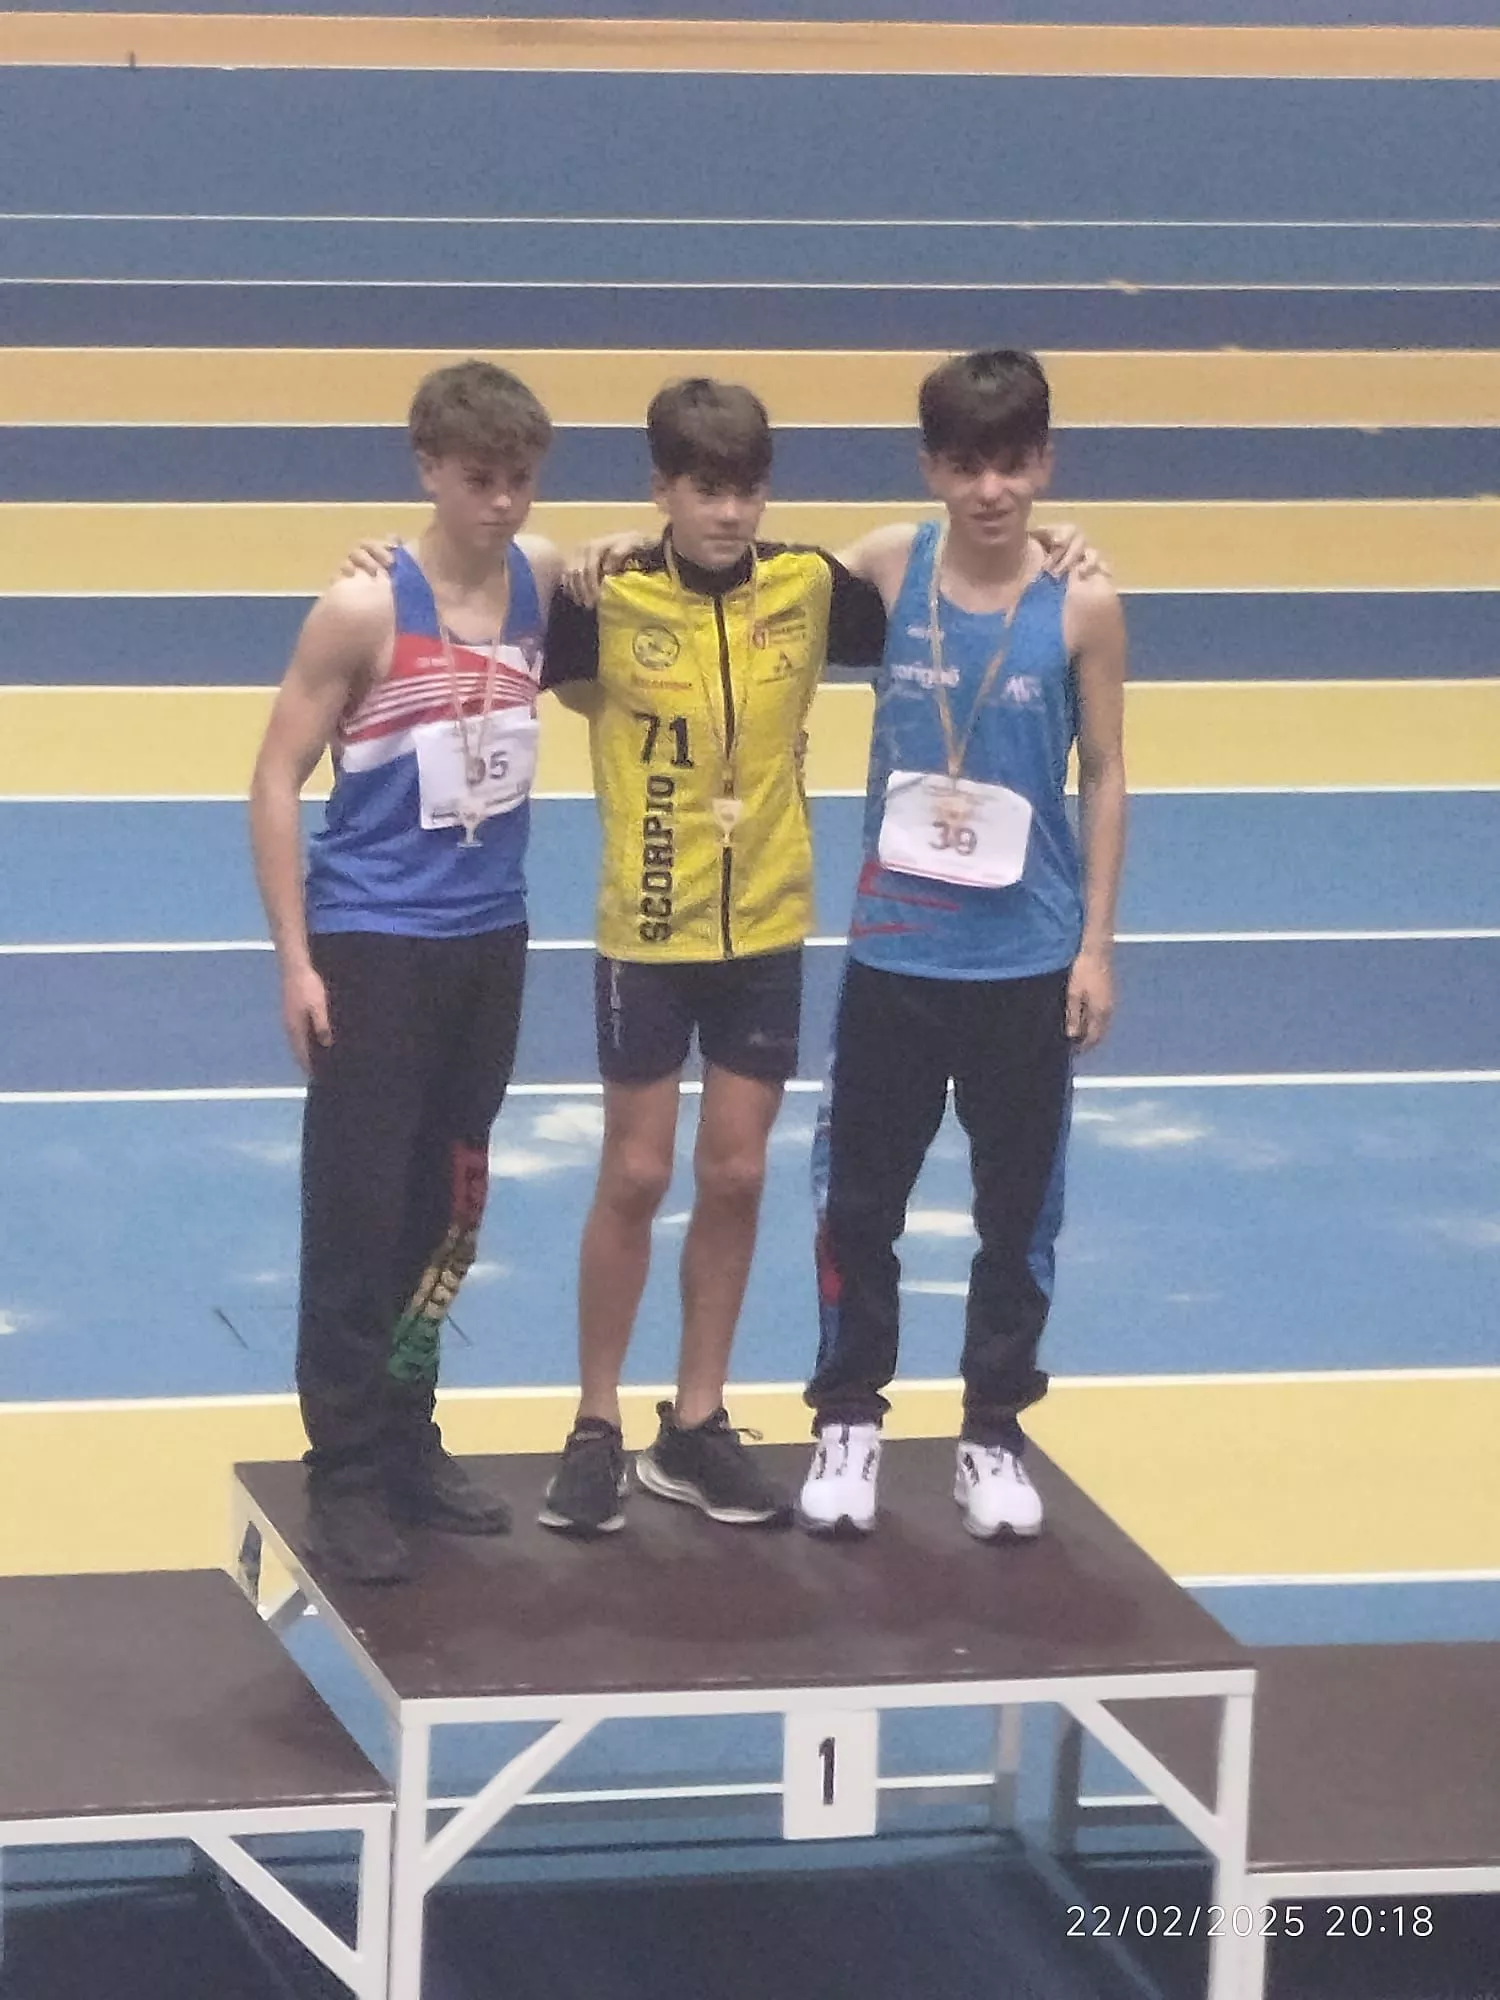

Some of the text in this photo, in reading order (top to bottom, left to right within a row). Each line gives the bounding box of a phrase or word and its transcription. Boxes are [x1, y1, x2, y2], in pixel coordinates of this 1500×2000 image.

[632, 710, 695, 769] 71
[640, 774, 676, 942] SCORPIO
[818, 1736, 836, 1806] 1
